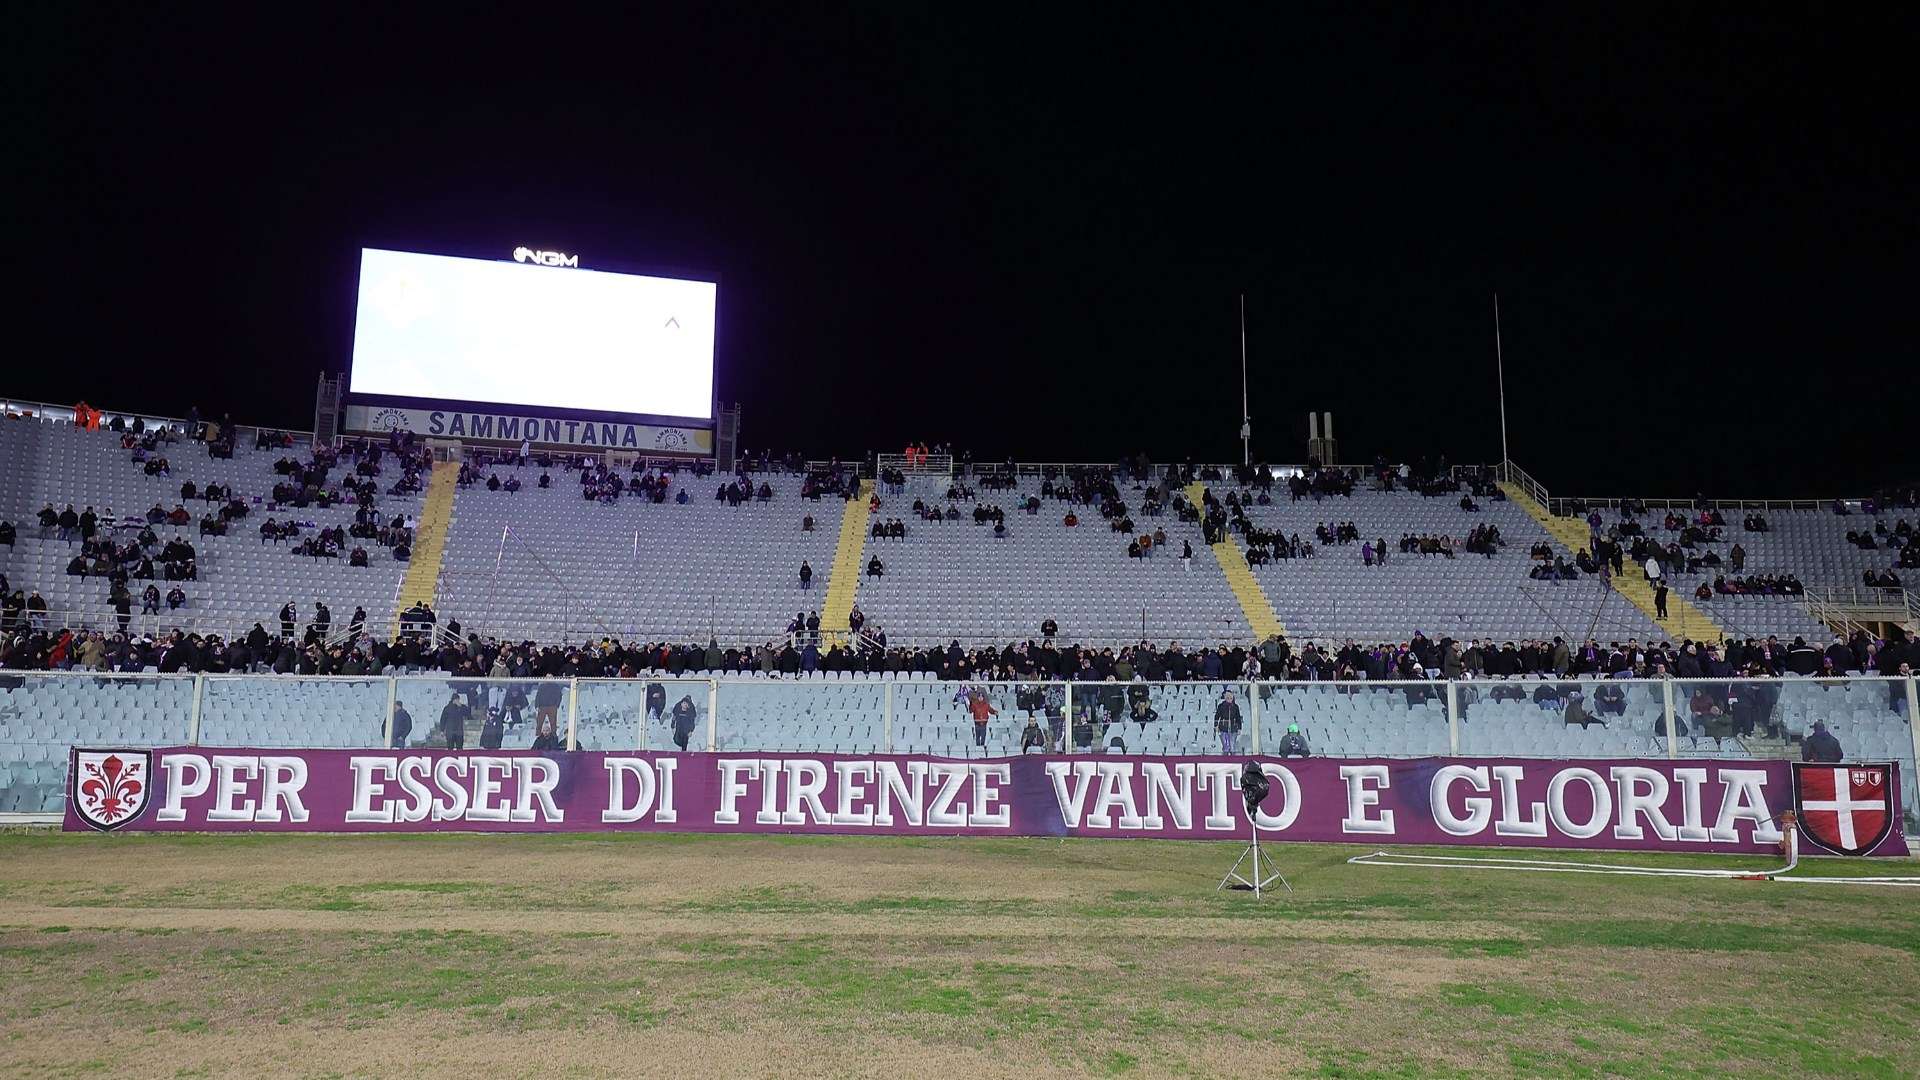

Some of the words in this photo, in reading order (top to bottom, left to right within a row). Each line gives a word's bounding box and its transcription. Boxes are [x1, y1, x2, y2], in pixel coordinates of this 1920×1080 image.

[525, 249, 579, 268] NGM
[428, 411, 638, 447] SAMMONTANA
[156, 754, 310, 824] PER
[345, 755, 565, 824] ESSER
[602, 757, 678, 824] DI
[714, 759, 1011, 828] FIRENZE
[1045, 761, 1302, 832] VANTO
[1339, 765, 1396, 835] E
[1430, 764, 1785, 844] GLORIA
